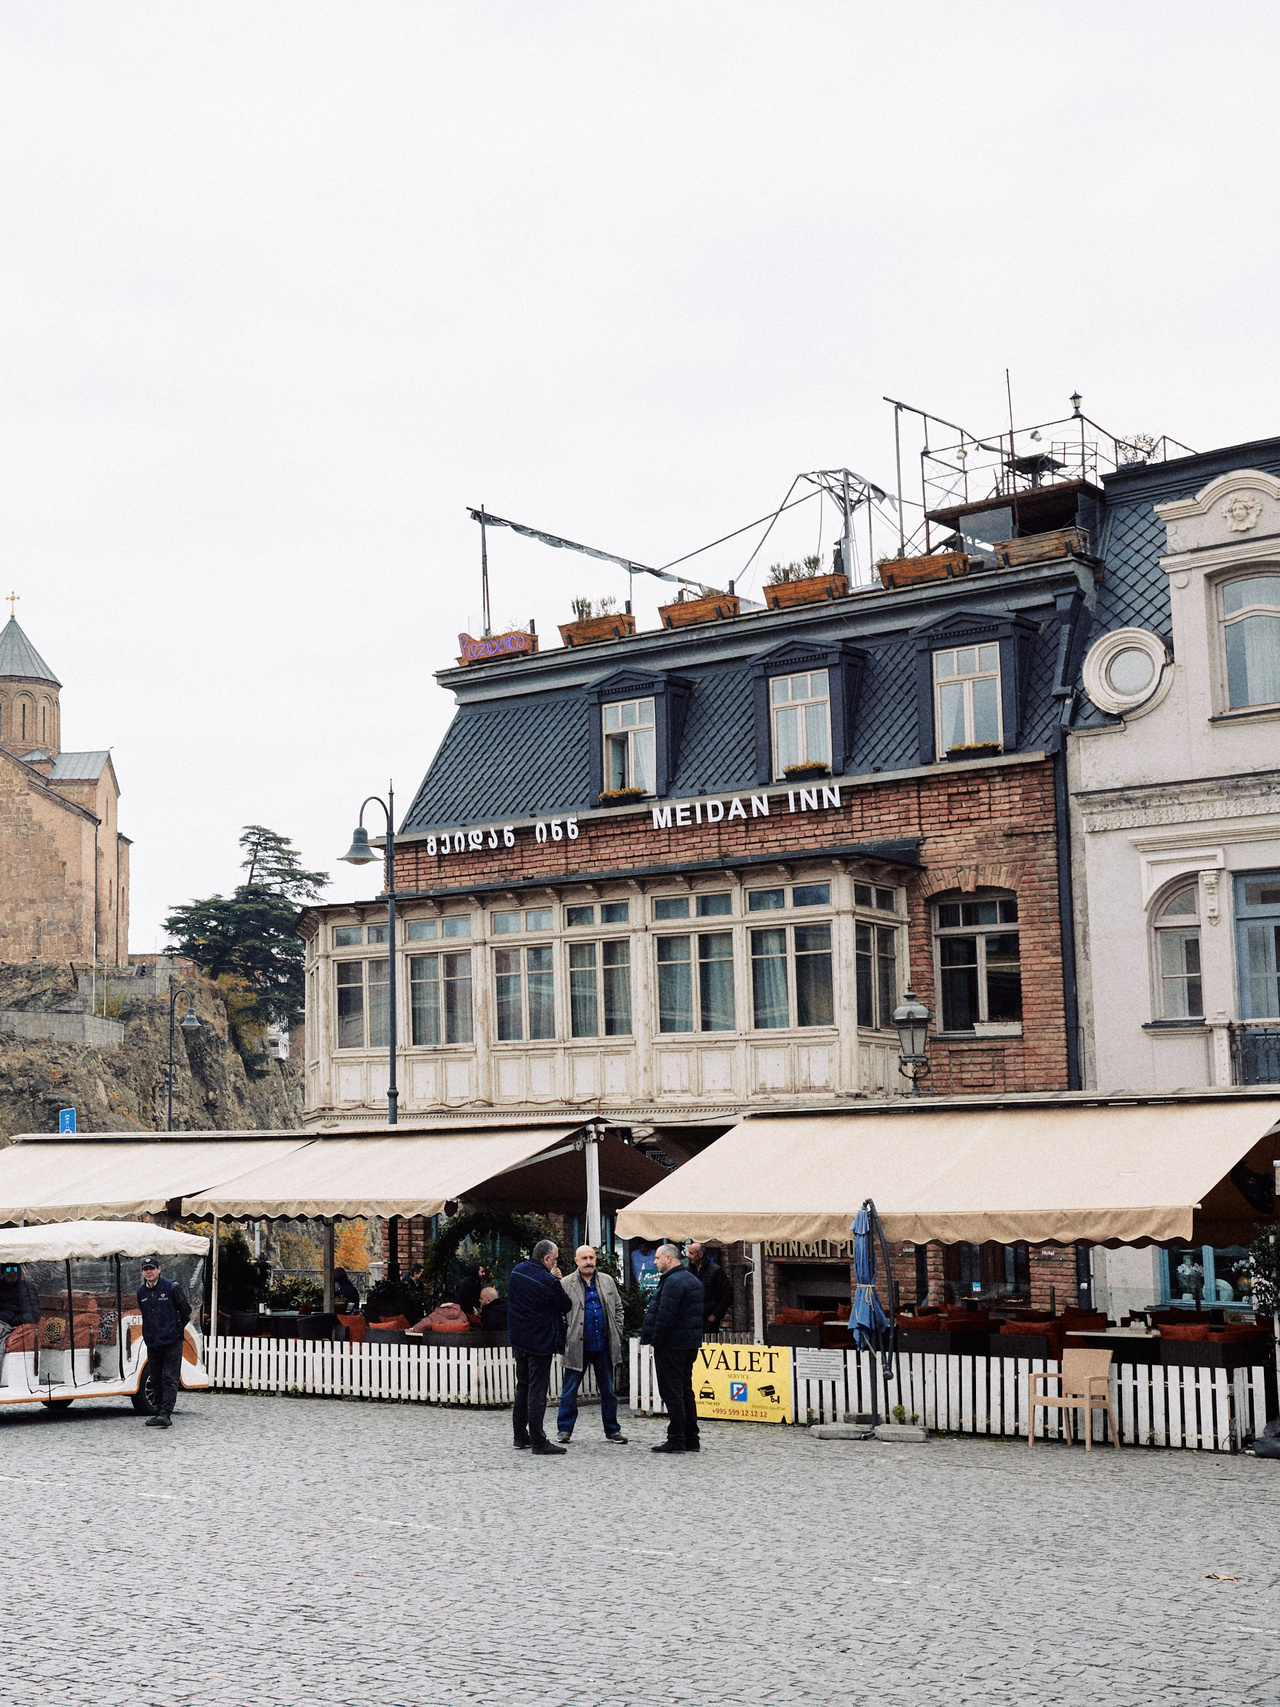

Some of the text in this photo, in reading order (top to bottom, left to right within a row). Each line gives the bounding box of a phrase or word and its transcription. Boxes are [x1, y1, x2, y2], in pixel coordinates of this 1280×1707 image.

[652, 784, 841, 830] MEIDAN INN
[426, 817, 579, 856] მეიდან ინნ
[764, 1239, 831, 1258] KHINKALI
[699, 1348, 780, 1374] VALET
[750, 1410, 758, 1418] 12
